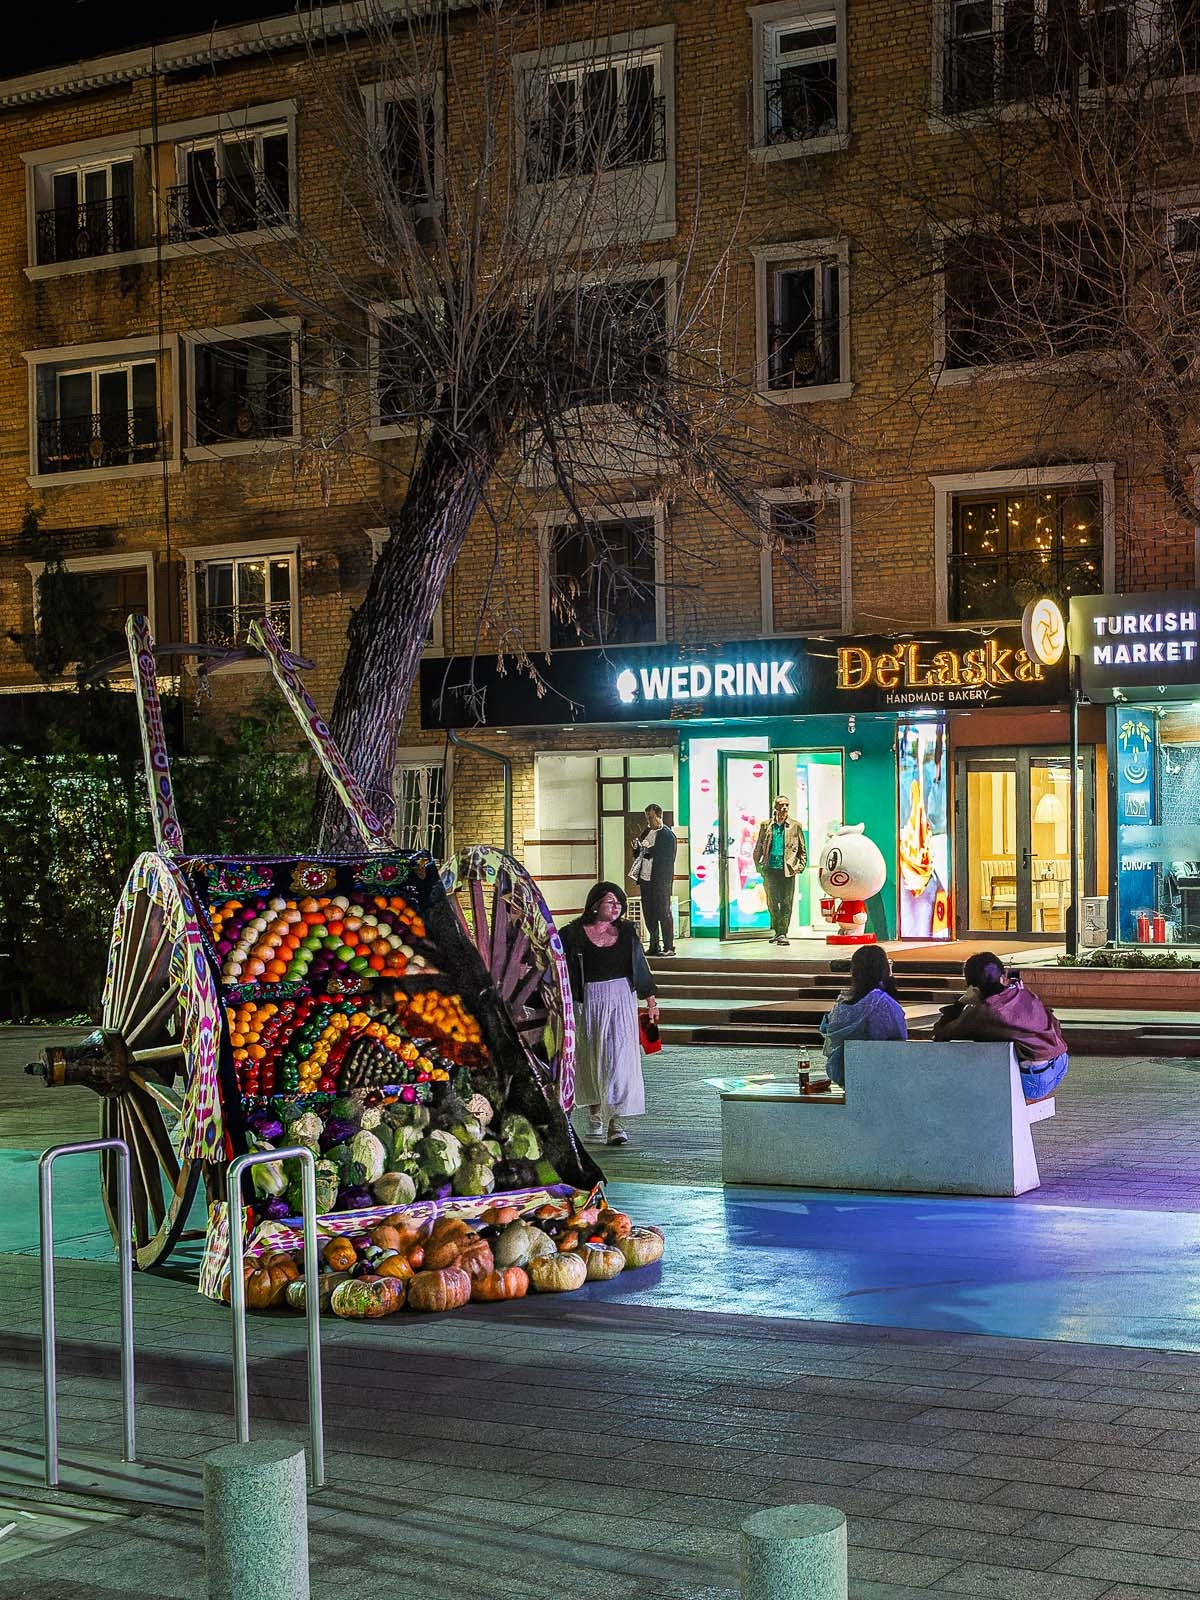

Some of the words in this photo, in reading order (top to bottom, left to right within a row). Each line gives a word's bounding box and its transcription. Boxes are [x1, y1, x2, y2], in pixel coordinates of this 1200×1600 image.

[1093, 611, 1197, 636] TURKISH
[1093, 641, 1198, 665] MARKET
[639, 661, 797, 701] WEDRINK
[886, 692, 945, 704] HANDMADE
[948, 689, 990, 701] BAKERY
